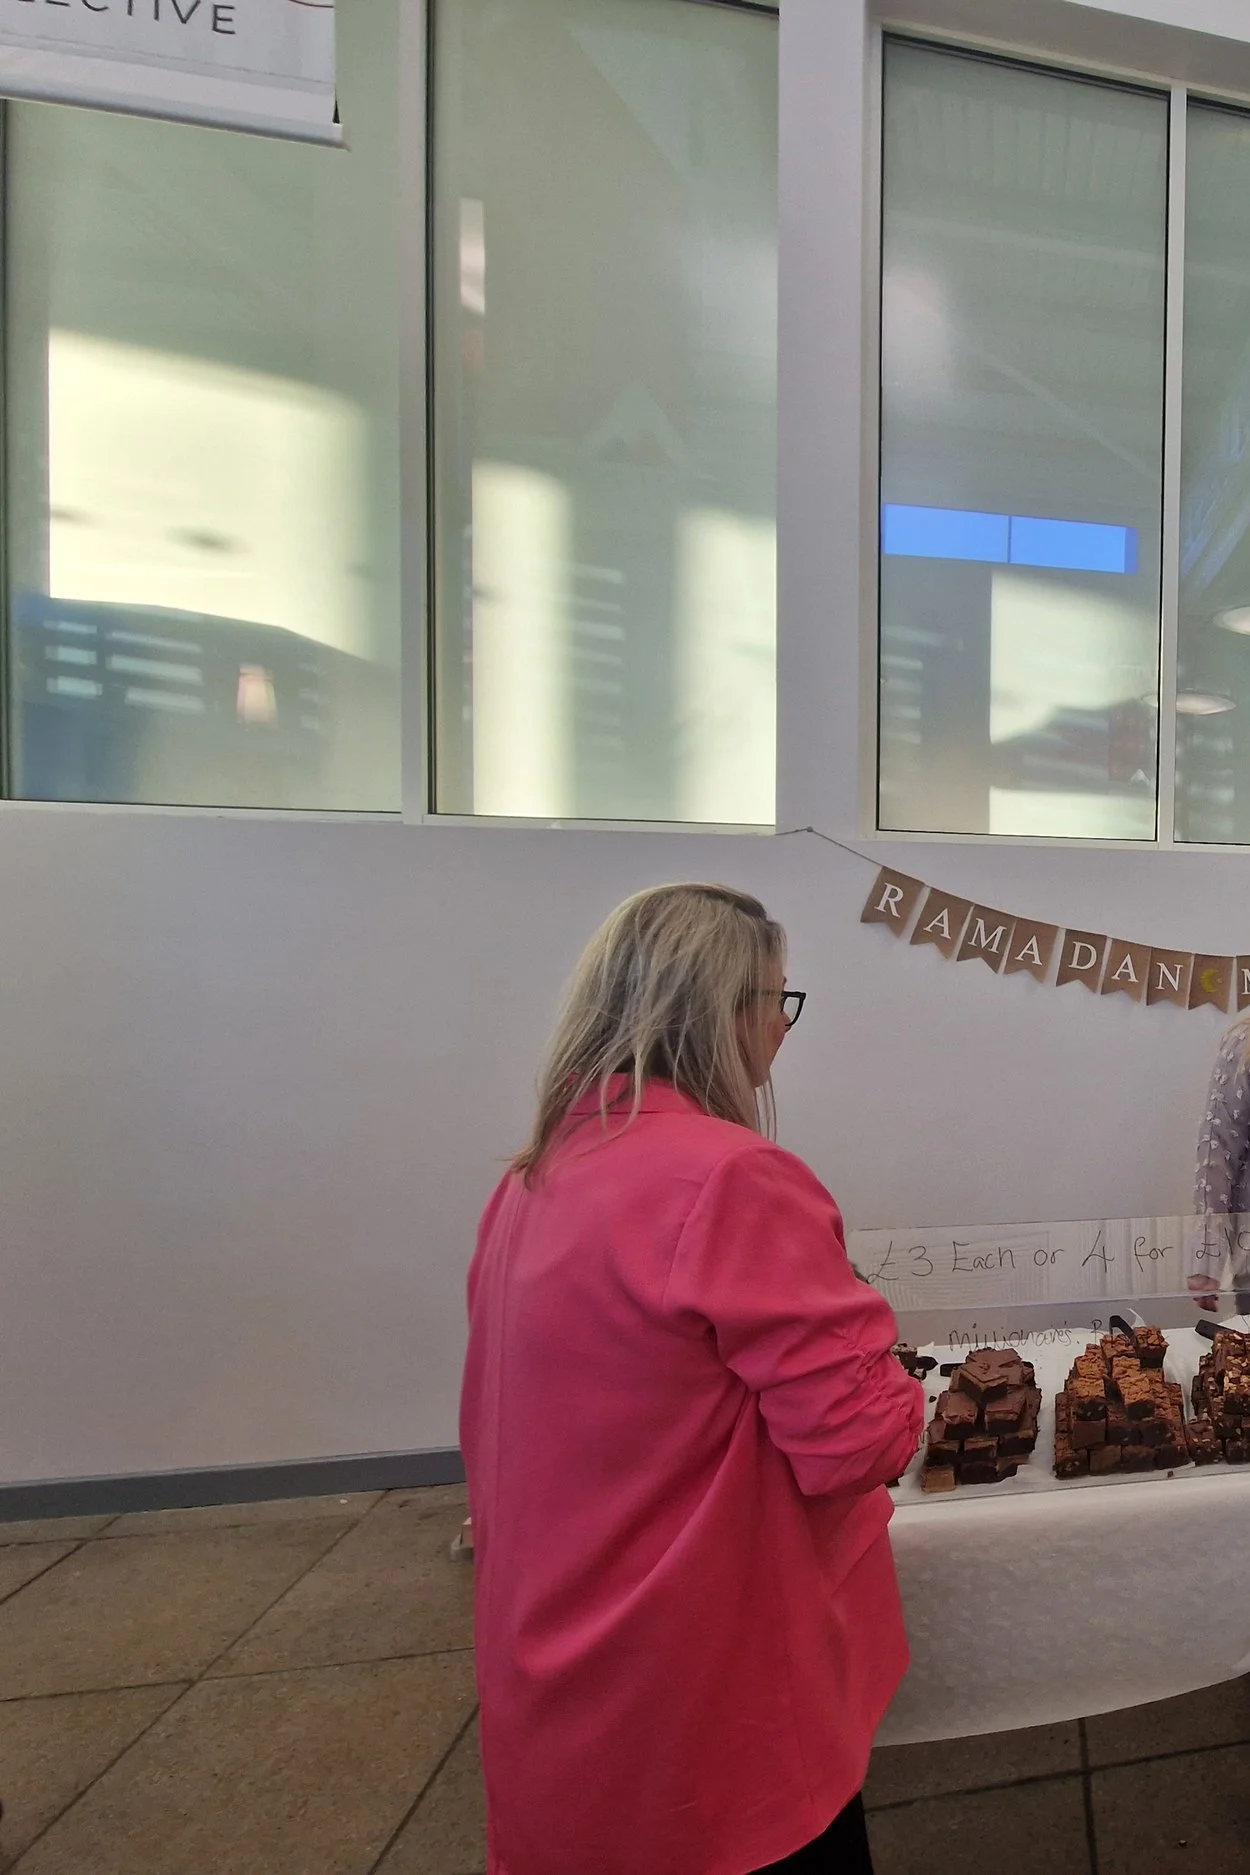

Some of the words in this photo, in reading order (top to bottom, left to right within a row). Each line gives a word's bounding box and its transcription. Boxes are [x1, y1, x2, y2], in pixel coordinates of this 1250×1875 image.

[873, 882, 1184, 992] RAMADAN
[866, 1240, 934, 1284] £3
[951, 1240, 1016, 1274] Each
[1033, 1247, 1066, 1268] or
[1082, 1230, 1114, 1273] 4
[1134, 1235, 1175, 1272] for
